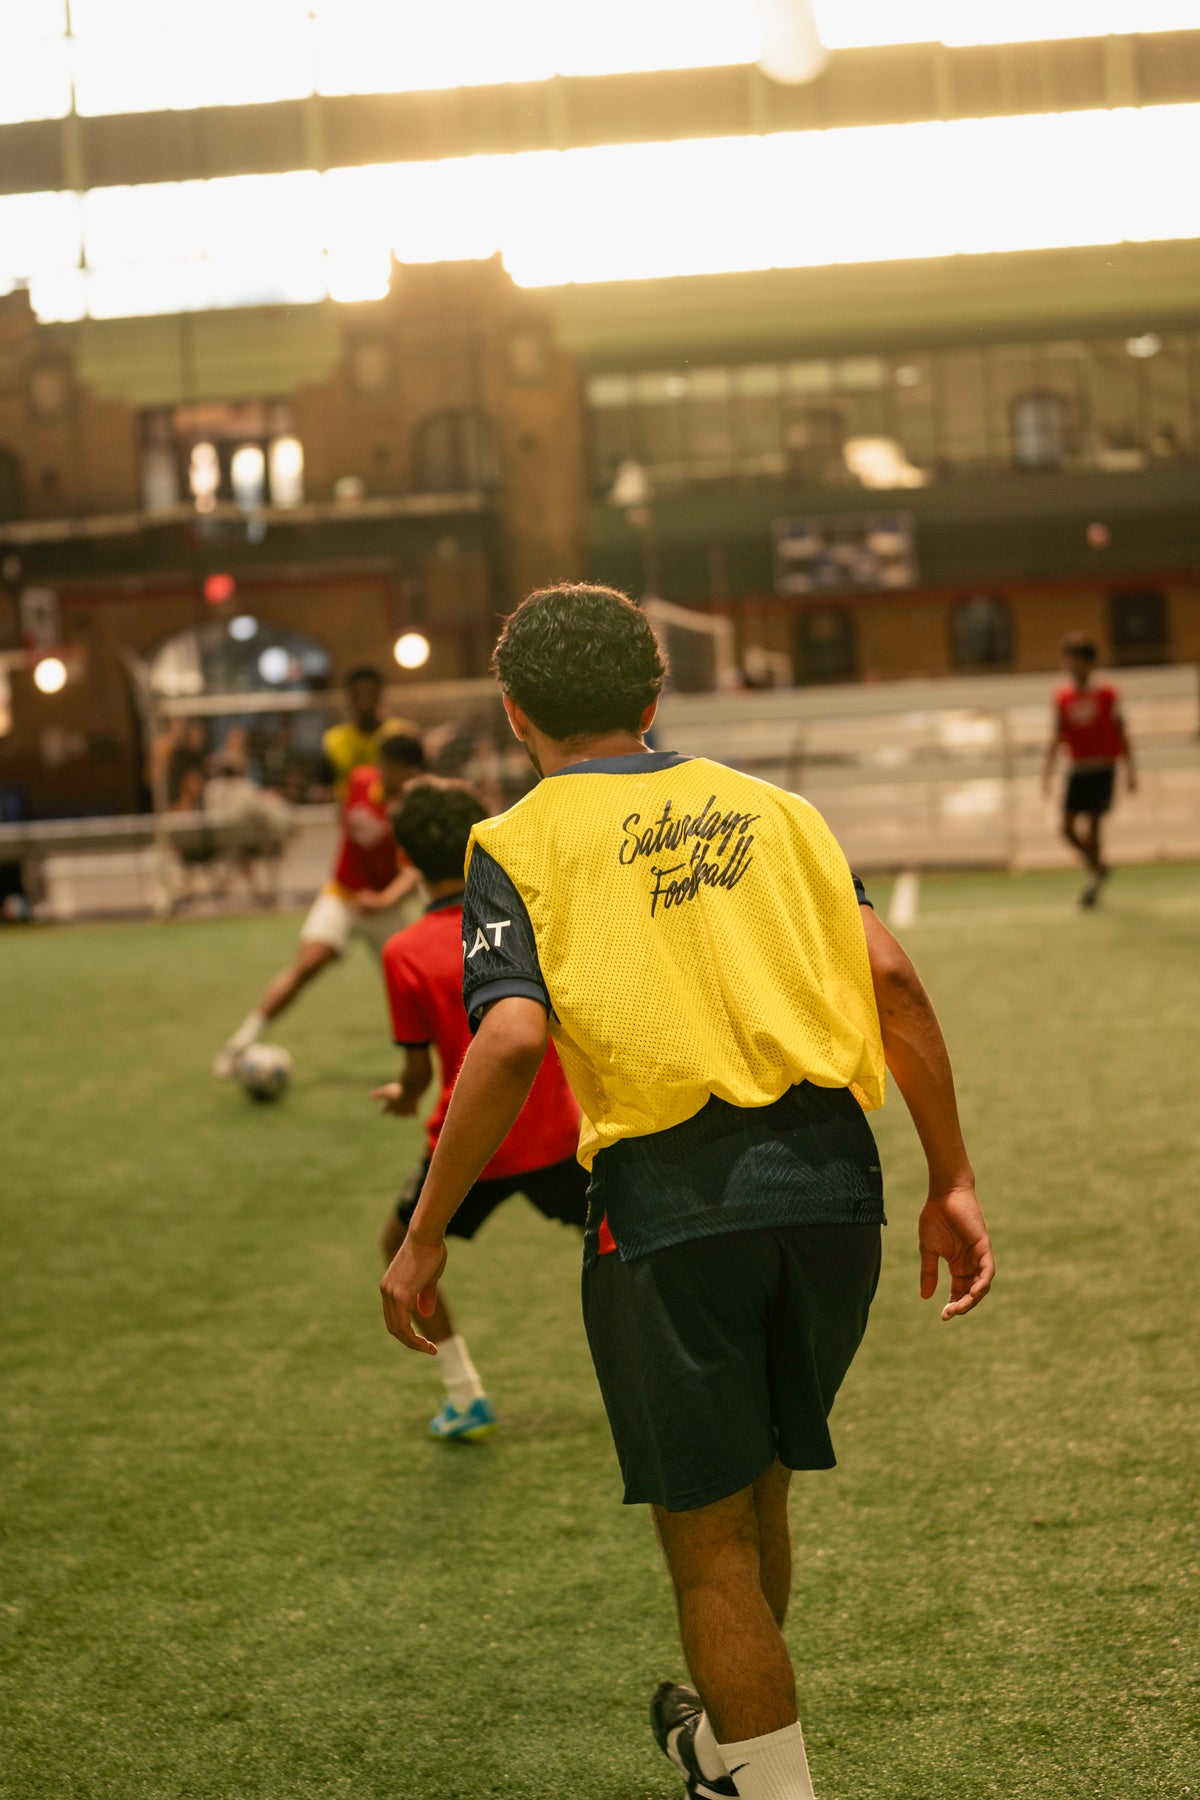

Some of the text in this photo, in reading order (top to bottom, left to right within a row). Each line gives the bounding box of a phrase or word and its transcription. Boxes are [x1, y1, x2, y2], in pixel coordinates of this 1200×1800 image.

[619, 795, 761, 865] Saturdays
[650, 835, 754, 918] Football
[462, 920, 511, 960] AT
